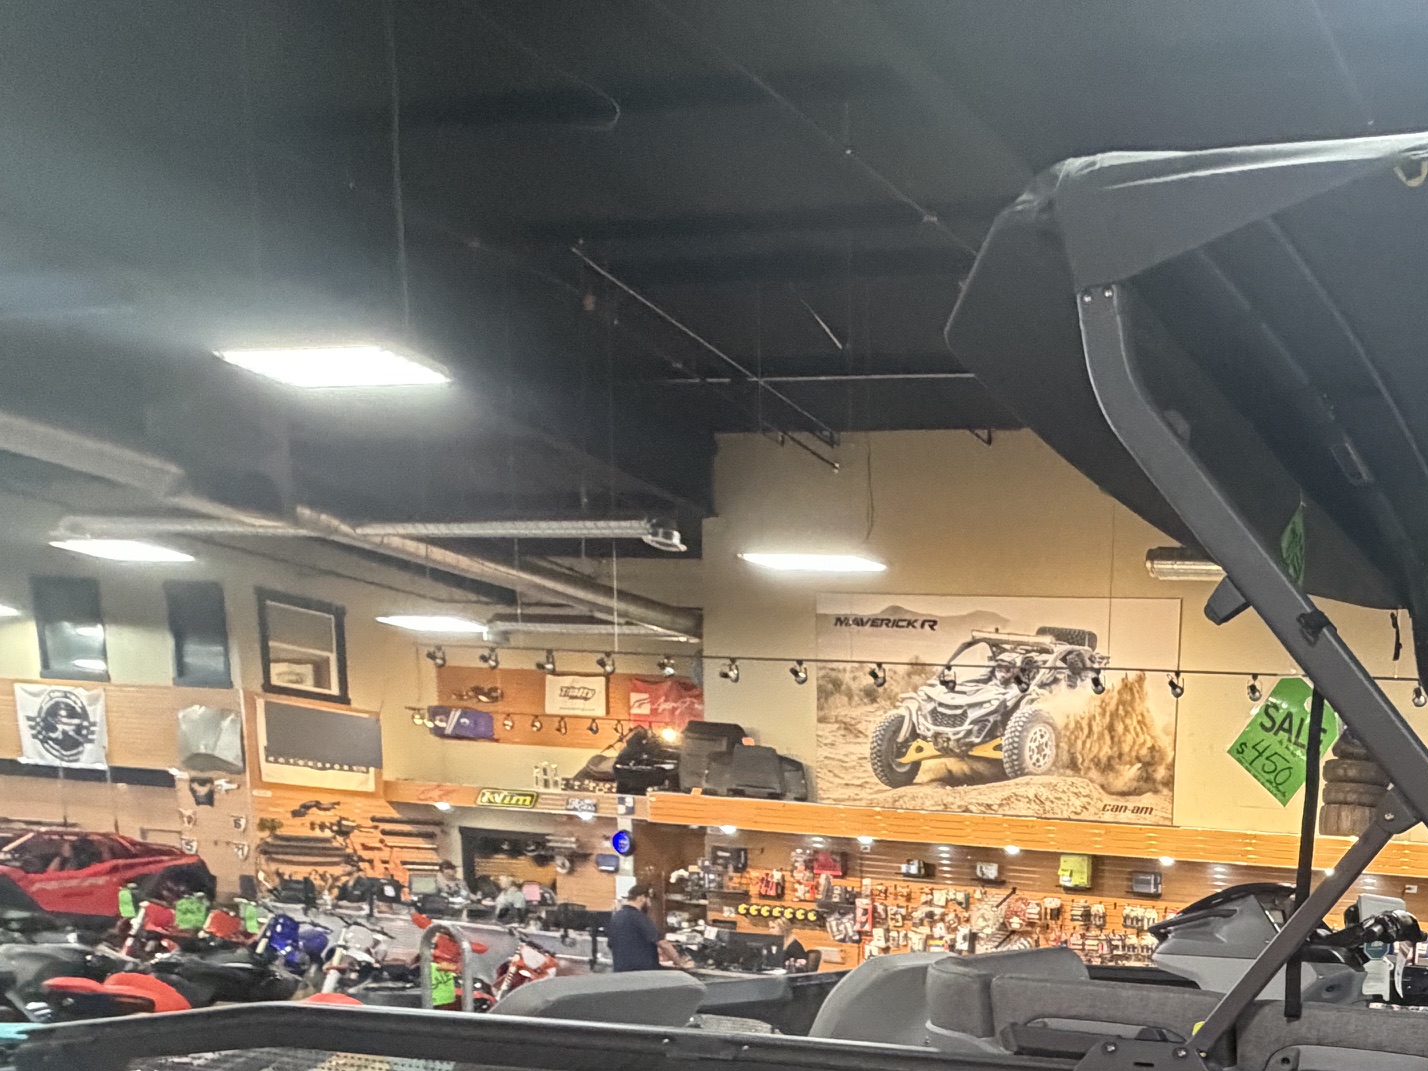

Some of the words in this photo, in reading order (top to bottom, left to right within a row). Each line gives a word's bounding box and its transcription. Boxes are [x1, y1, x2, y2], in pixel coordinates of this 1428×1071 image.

[834, 616, 918, 629] MAVERICK
[920, 619, 938, 631] R
[1258, 701, 1328, 750] SAL
[1101, 803, 1154, 816] can-am
